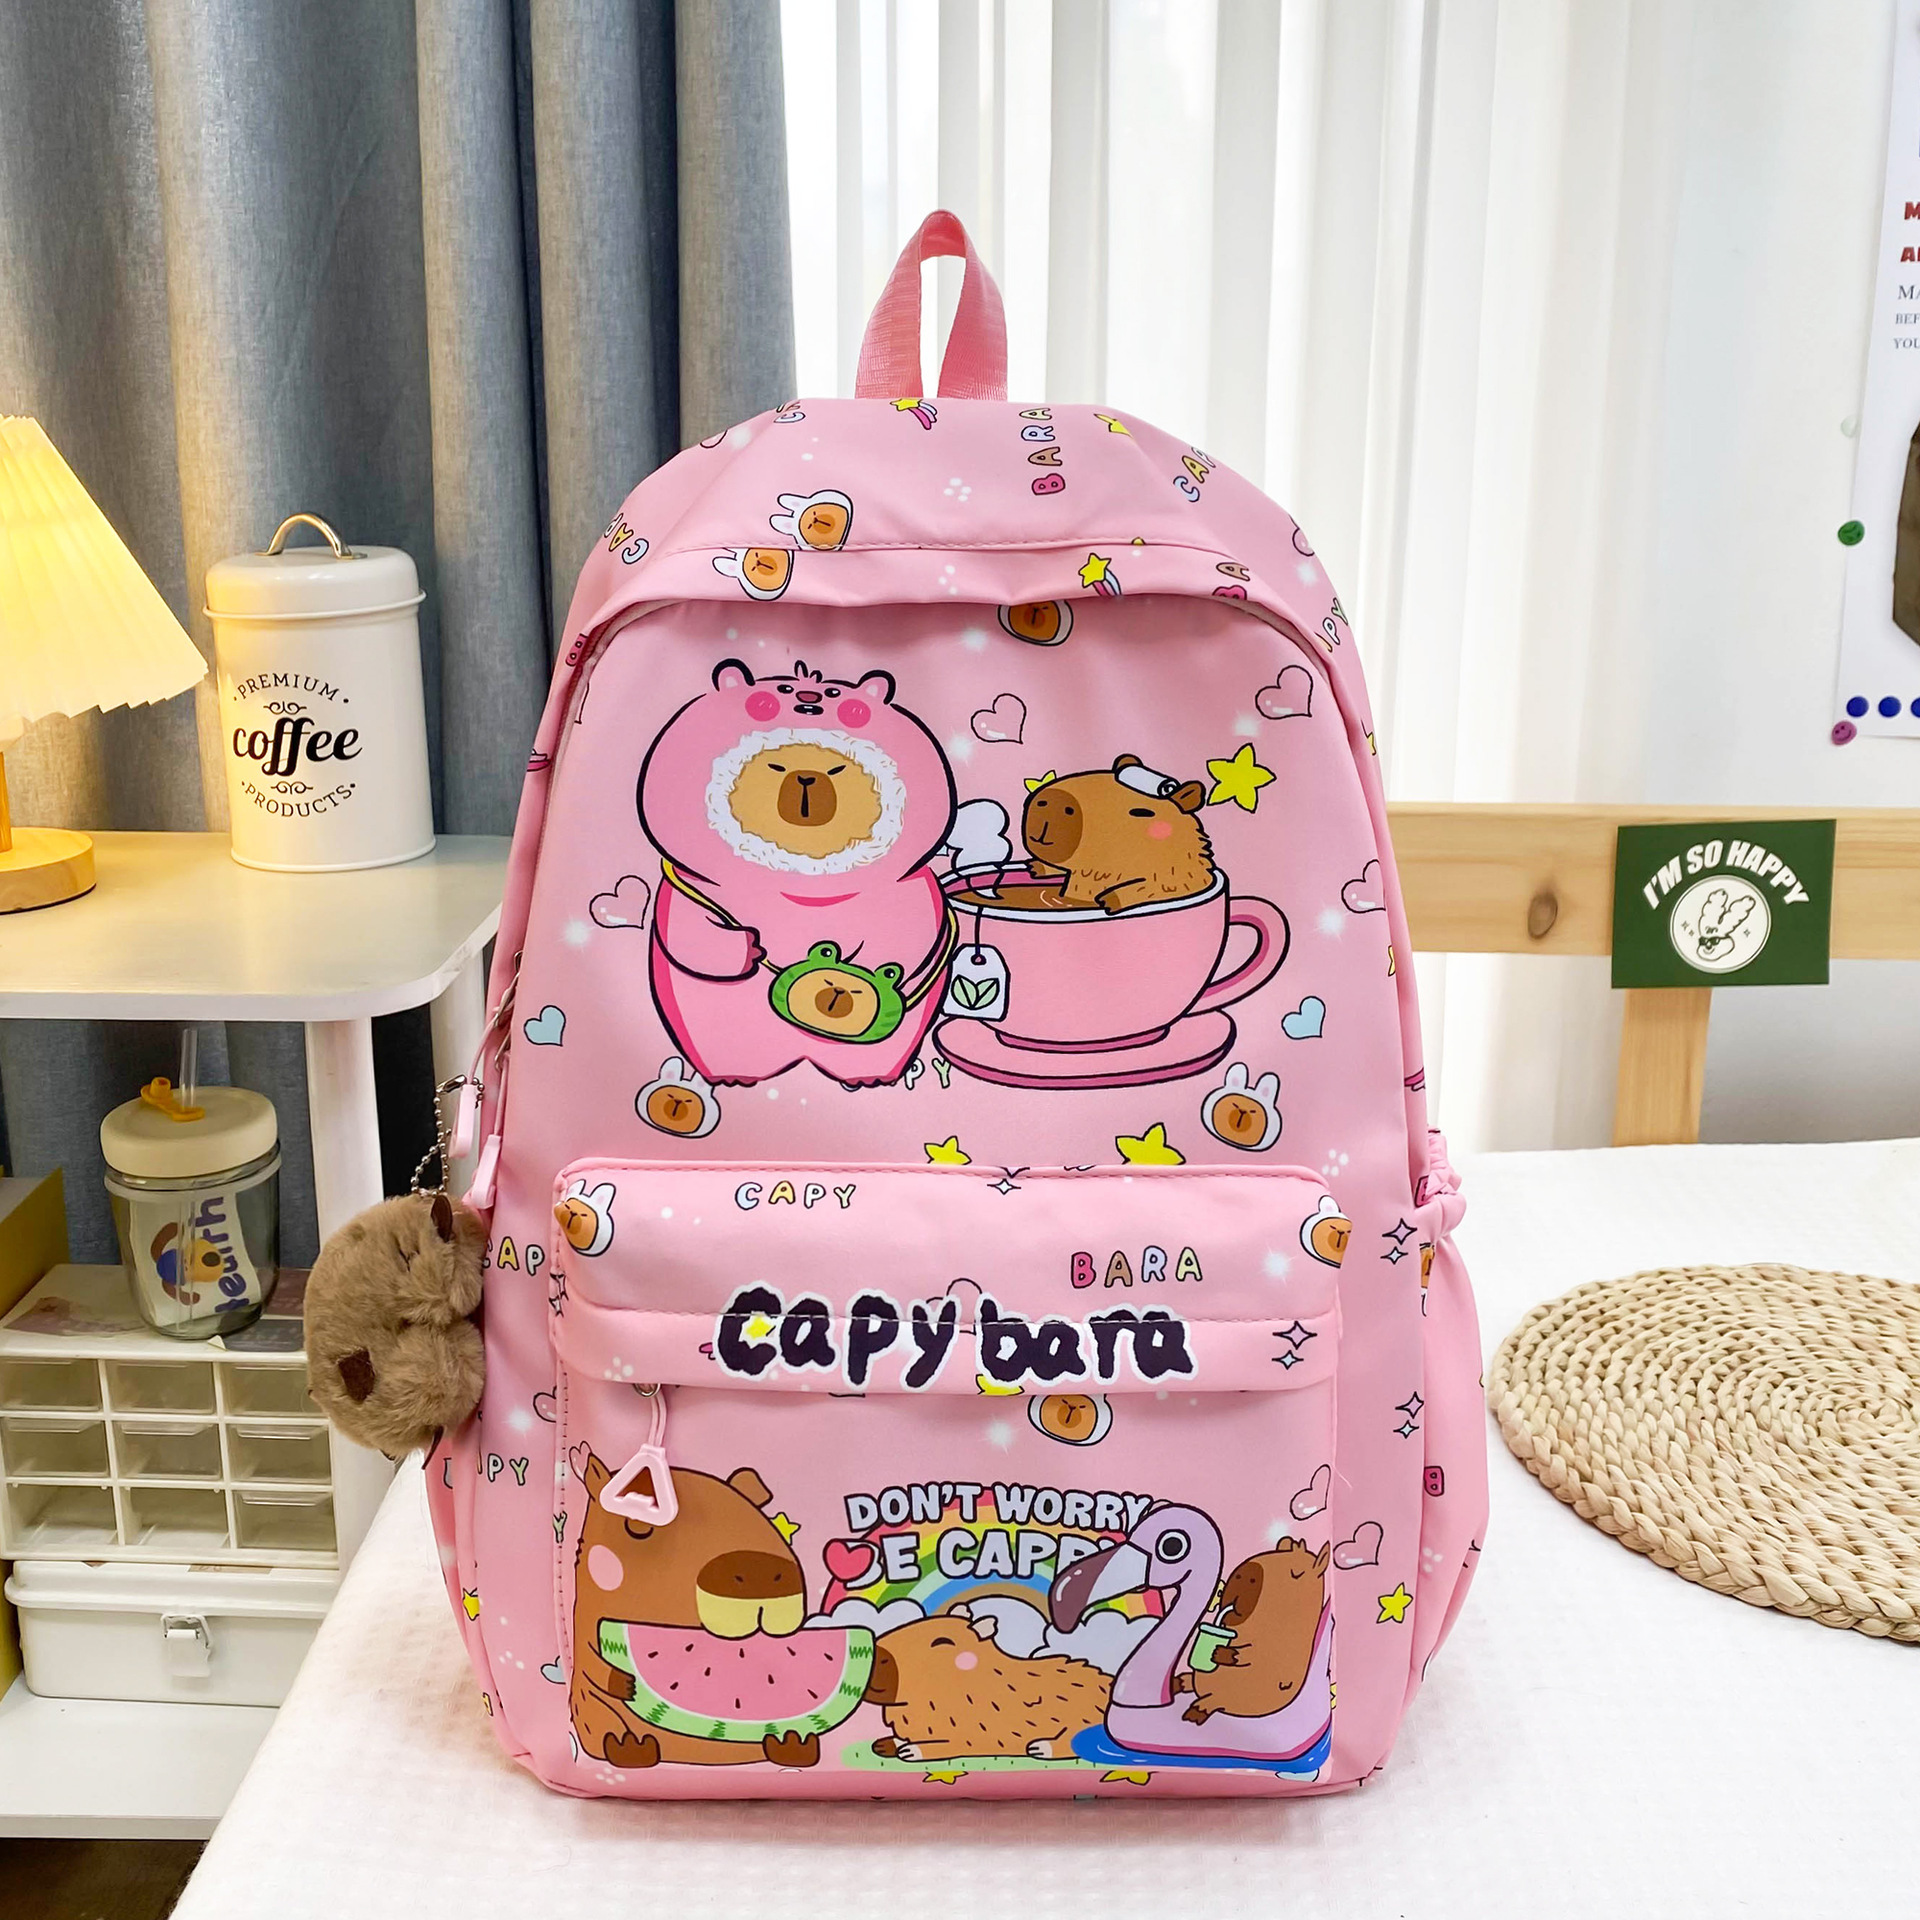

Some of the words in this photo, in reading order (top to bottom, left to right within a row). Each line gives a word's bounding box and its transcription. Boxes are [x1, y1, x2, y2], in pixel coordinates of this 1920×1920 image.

[1900, 246, 1920, 262] A
[1019, 407, 1066, 496] BARA
[1314, 596, 1349, 653] PY
[237, 672, 340, 701] PREMIUM
[232, 717, 363, 777] coffee
[244, 782, 352, 818] PRODUCTS
[1643, 855, 1683, 910] I'M
[1686, 839, 1724, 875] SO
[1726, 839, 1810, 905] HAPPY
[734, 1180, 857, 1211] CAPY
[1071, 1245, 1203, 1289] BARA
[843, 1481, 983, 1533] DON'T
[994, 1483, 1154, 1533] WORRY
[936, 1527, 1118, 1580] CAPP
